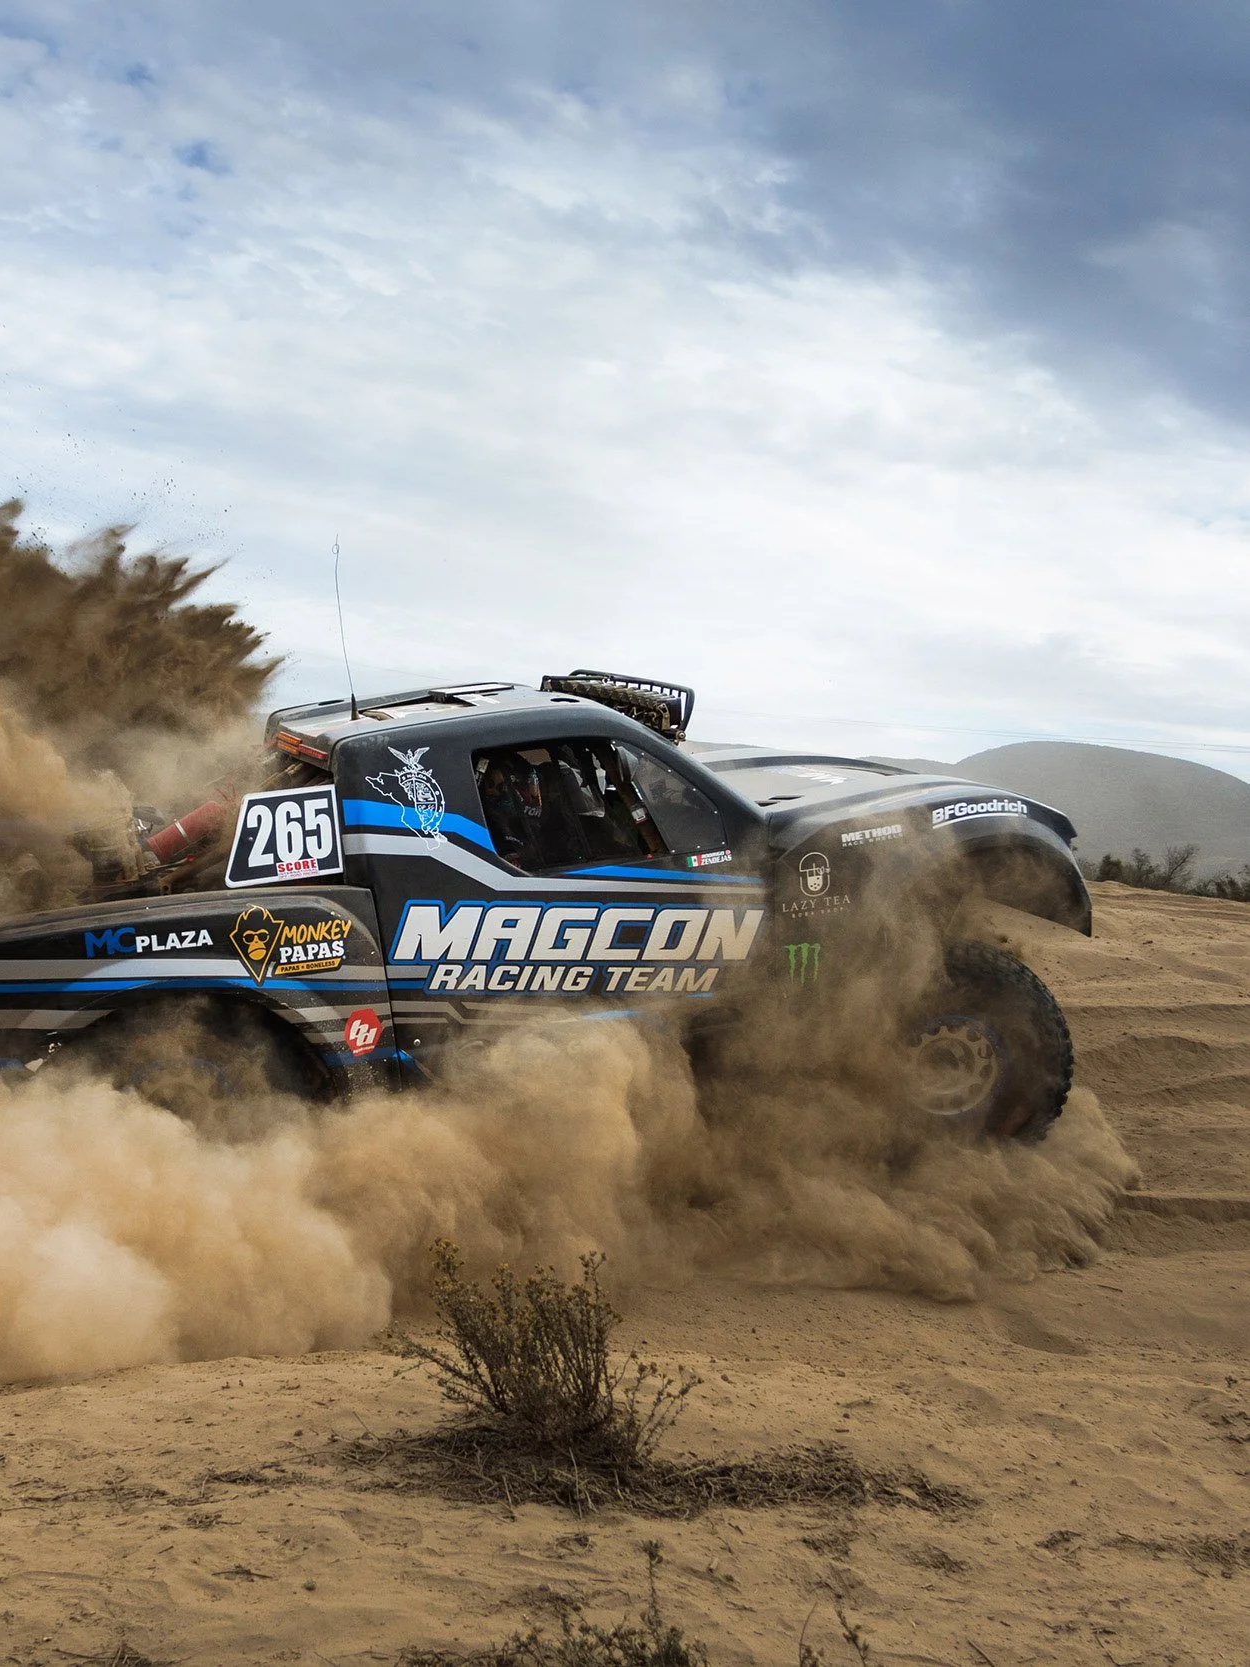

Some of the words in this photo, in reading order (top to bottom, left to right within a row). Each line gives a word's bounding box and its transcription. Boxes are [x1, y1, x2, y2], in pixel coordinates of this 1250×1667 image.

[932, 799, 1028, 825] BFGoodrich
[247, 798, 333, 868] 265
[841, 824, 902, 843] METHOD
[277, 859, 317, 873] SCORE
[701, 854, 732, 866] ZENDEJAS
[782, 899, 817, 913] LAZY
[823, 894, 851, 906] TEA
[135, 929, 213, 953] PLAZA
[280, 919, 352, 945] MONKEY
[393, 905, 765, 961] MAGCON
[279, 940, 345, 963] PAPAS
[429, 965, 592, 992] RACING
[607, 966, 720, 993] TEAM
